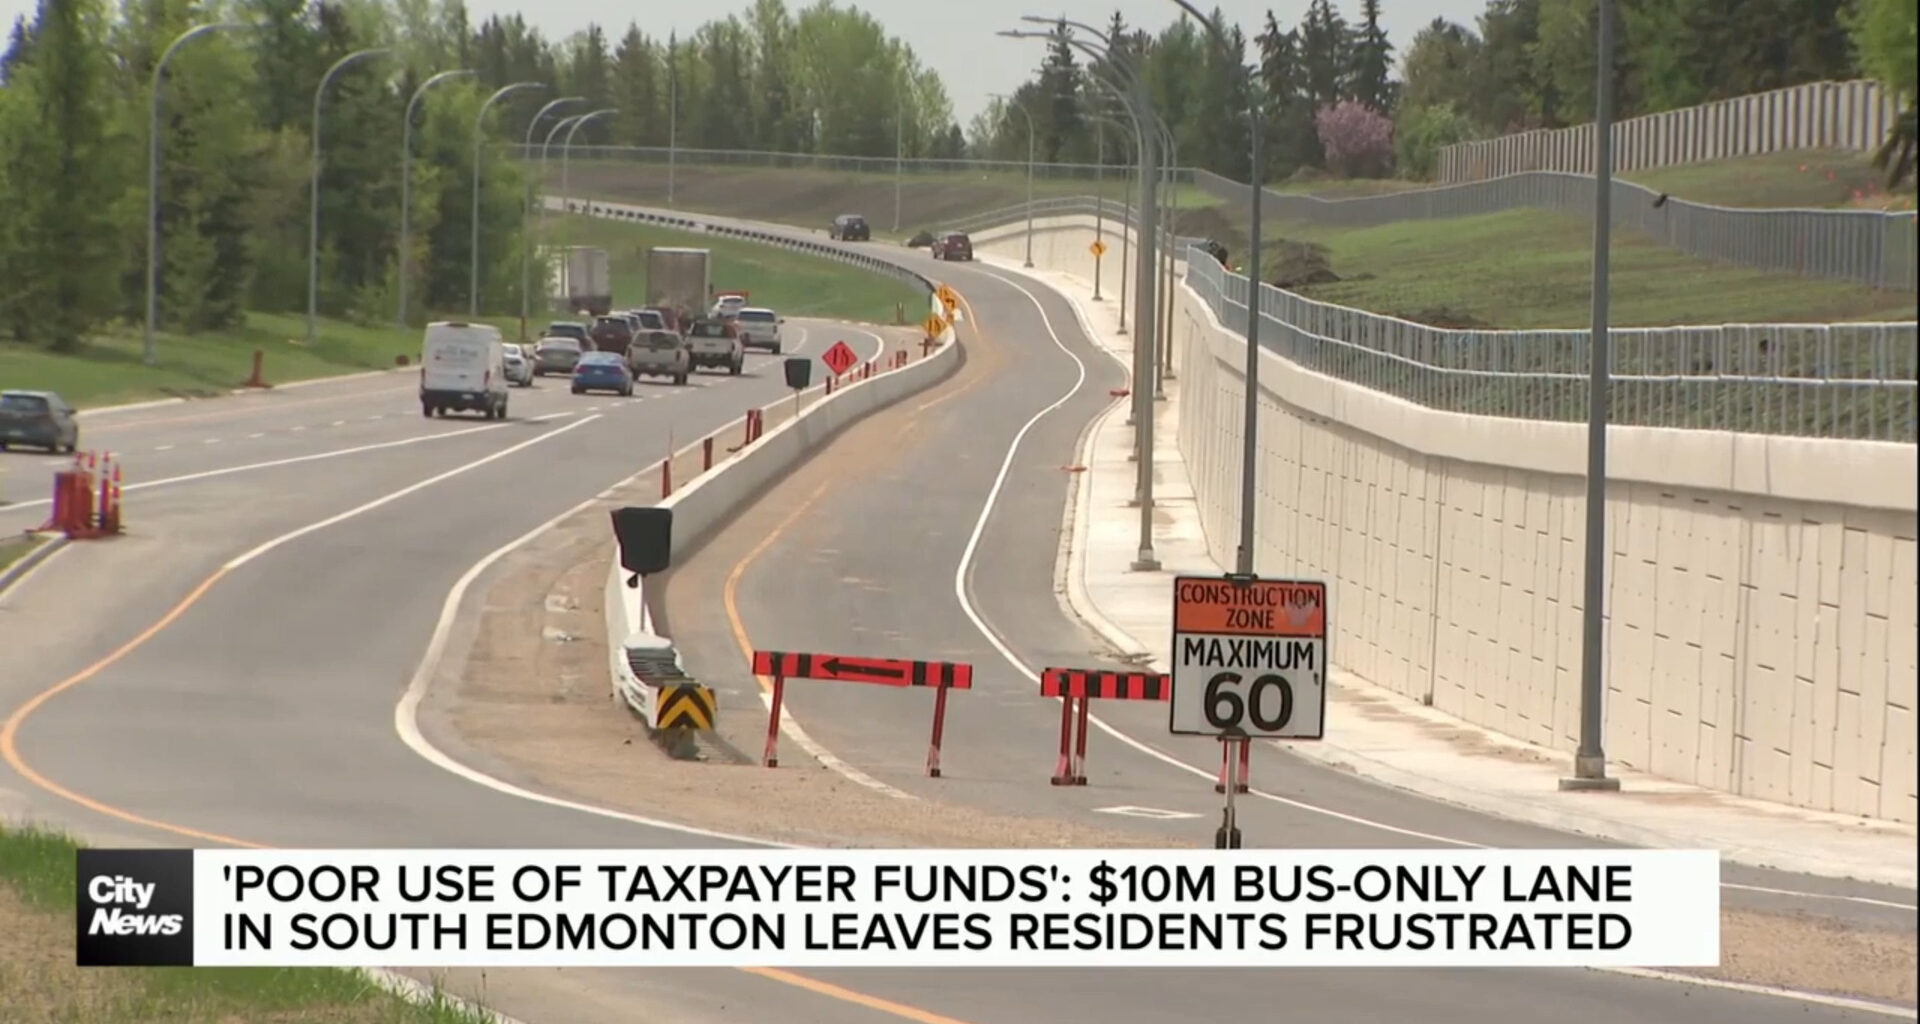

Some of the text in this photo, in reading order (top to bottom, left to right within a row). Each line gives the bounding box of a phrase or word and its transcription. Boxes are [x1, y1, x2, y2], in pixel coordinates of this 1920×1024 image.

[1180, 584, 1321, 609] CONSTRUCTION
[1226, 608, 1275, 630] ZONE
[1184, 637, 1314, 671] MAXIMUM
[1203, 671, 1294, 733] 60
